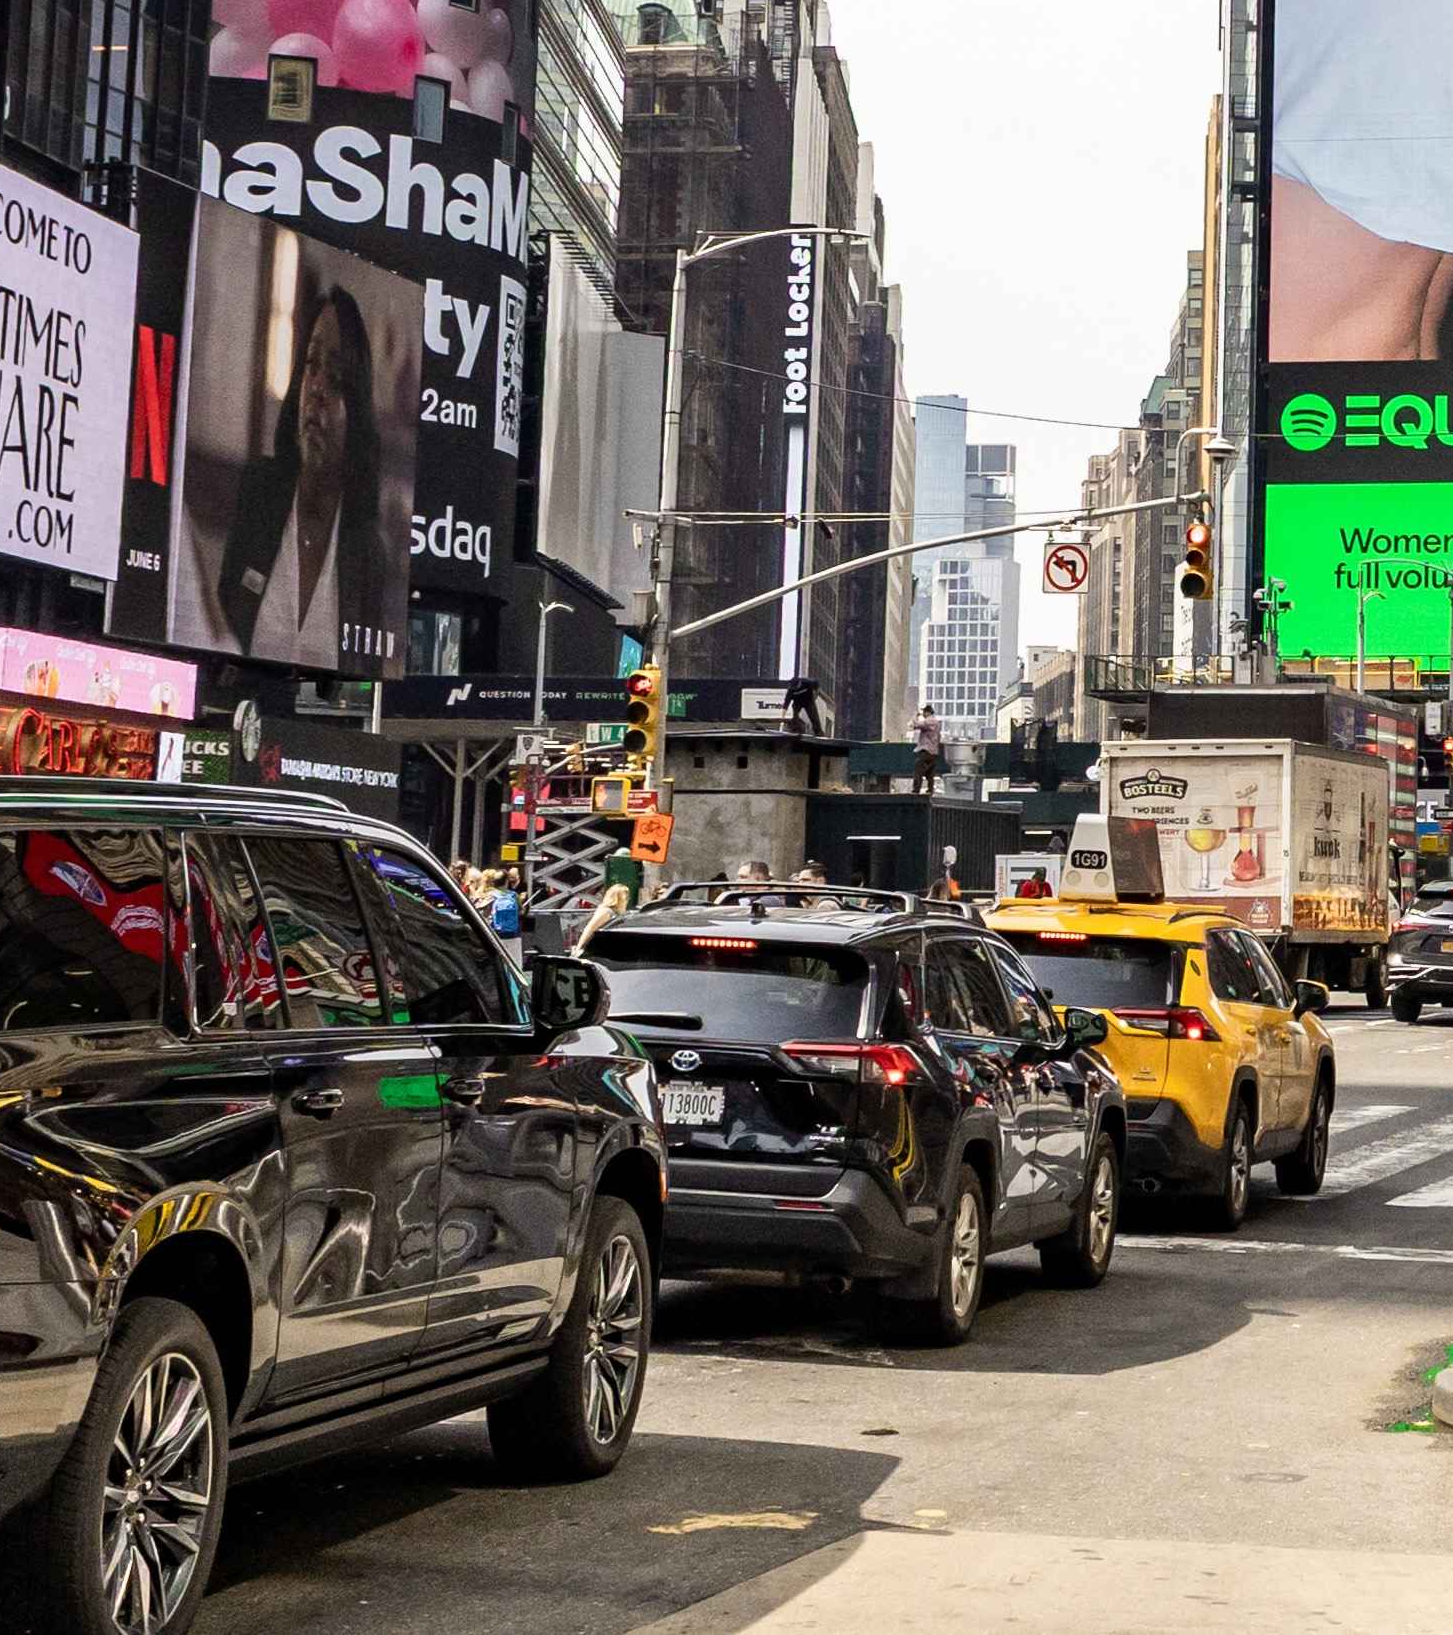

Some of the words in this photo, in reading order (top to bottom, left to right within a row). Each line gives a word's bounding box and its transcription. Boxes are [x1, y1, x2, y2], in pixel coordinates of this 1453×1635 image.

[63, 223, 93, 276] TO
[784, 233, 812, 338] Locker
[422, 278, 491, 380] ty
[782, 347, 808, 414] Foot
[129, 323, 177, 487] N
[420, 387, 478, 429] 2am
[6, 500, 75, 555] .COM
[125, 548, 152, 571] JUNE
[153, 552, 161, 572] 6
[1334, 559, 1382, 591] full
[341, 622, 395, 659] STRAW
[478, 689, 532, 701] QUESTION
[1122, 782, 1185, 799] BOSTEELS
[1131, 806, 1150, 815] TWO
[1152, 806, 1176, 815] BEERS
[1073, 852, 1107, 867] 1G91
